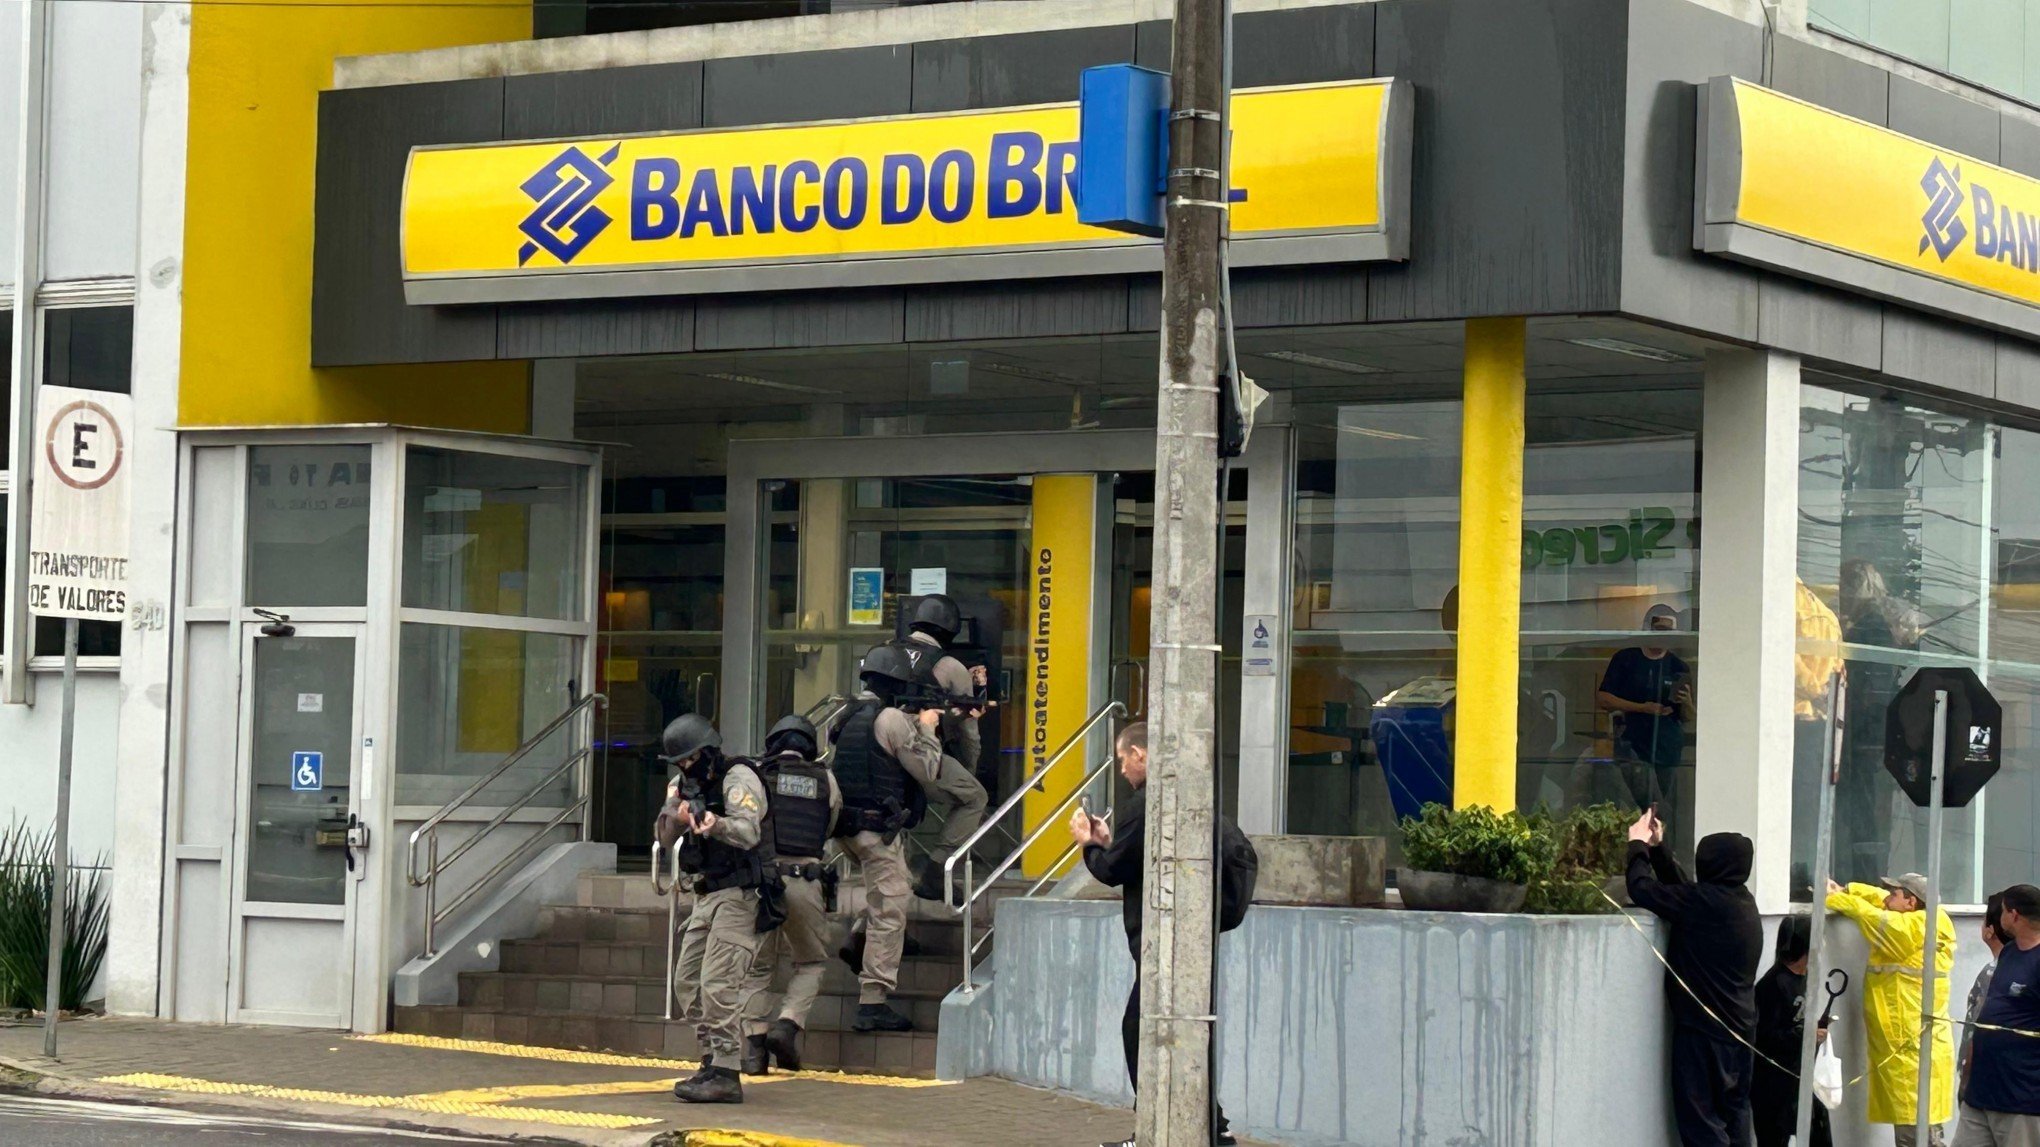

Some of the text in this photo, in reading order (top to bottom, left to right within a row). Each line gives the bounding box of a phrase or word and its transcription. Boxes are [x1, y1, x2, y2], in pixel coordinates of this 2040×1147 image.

[630, 157, 868, 241] BANCO
[880, 149, 975, 225] DO
[1970, 183, 2040, 274] BAN
[72, 422, 98, 469] E
[31, 551, 128, 581] TRANSPORTE
[30, 584, 126, 613] DE VALORES
